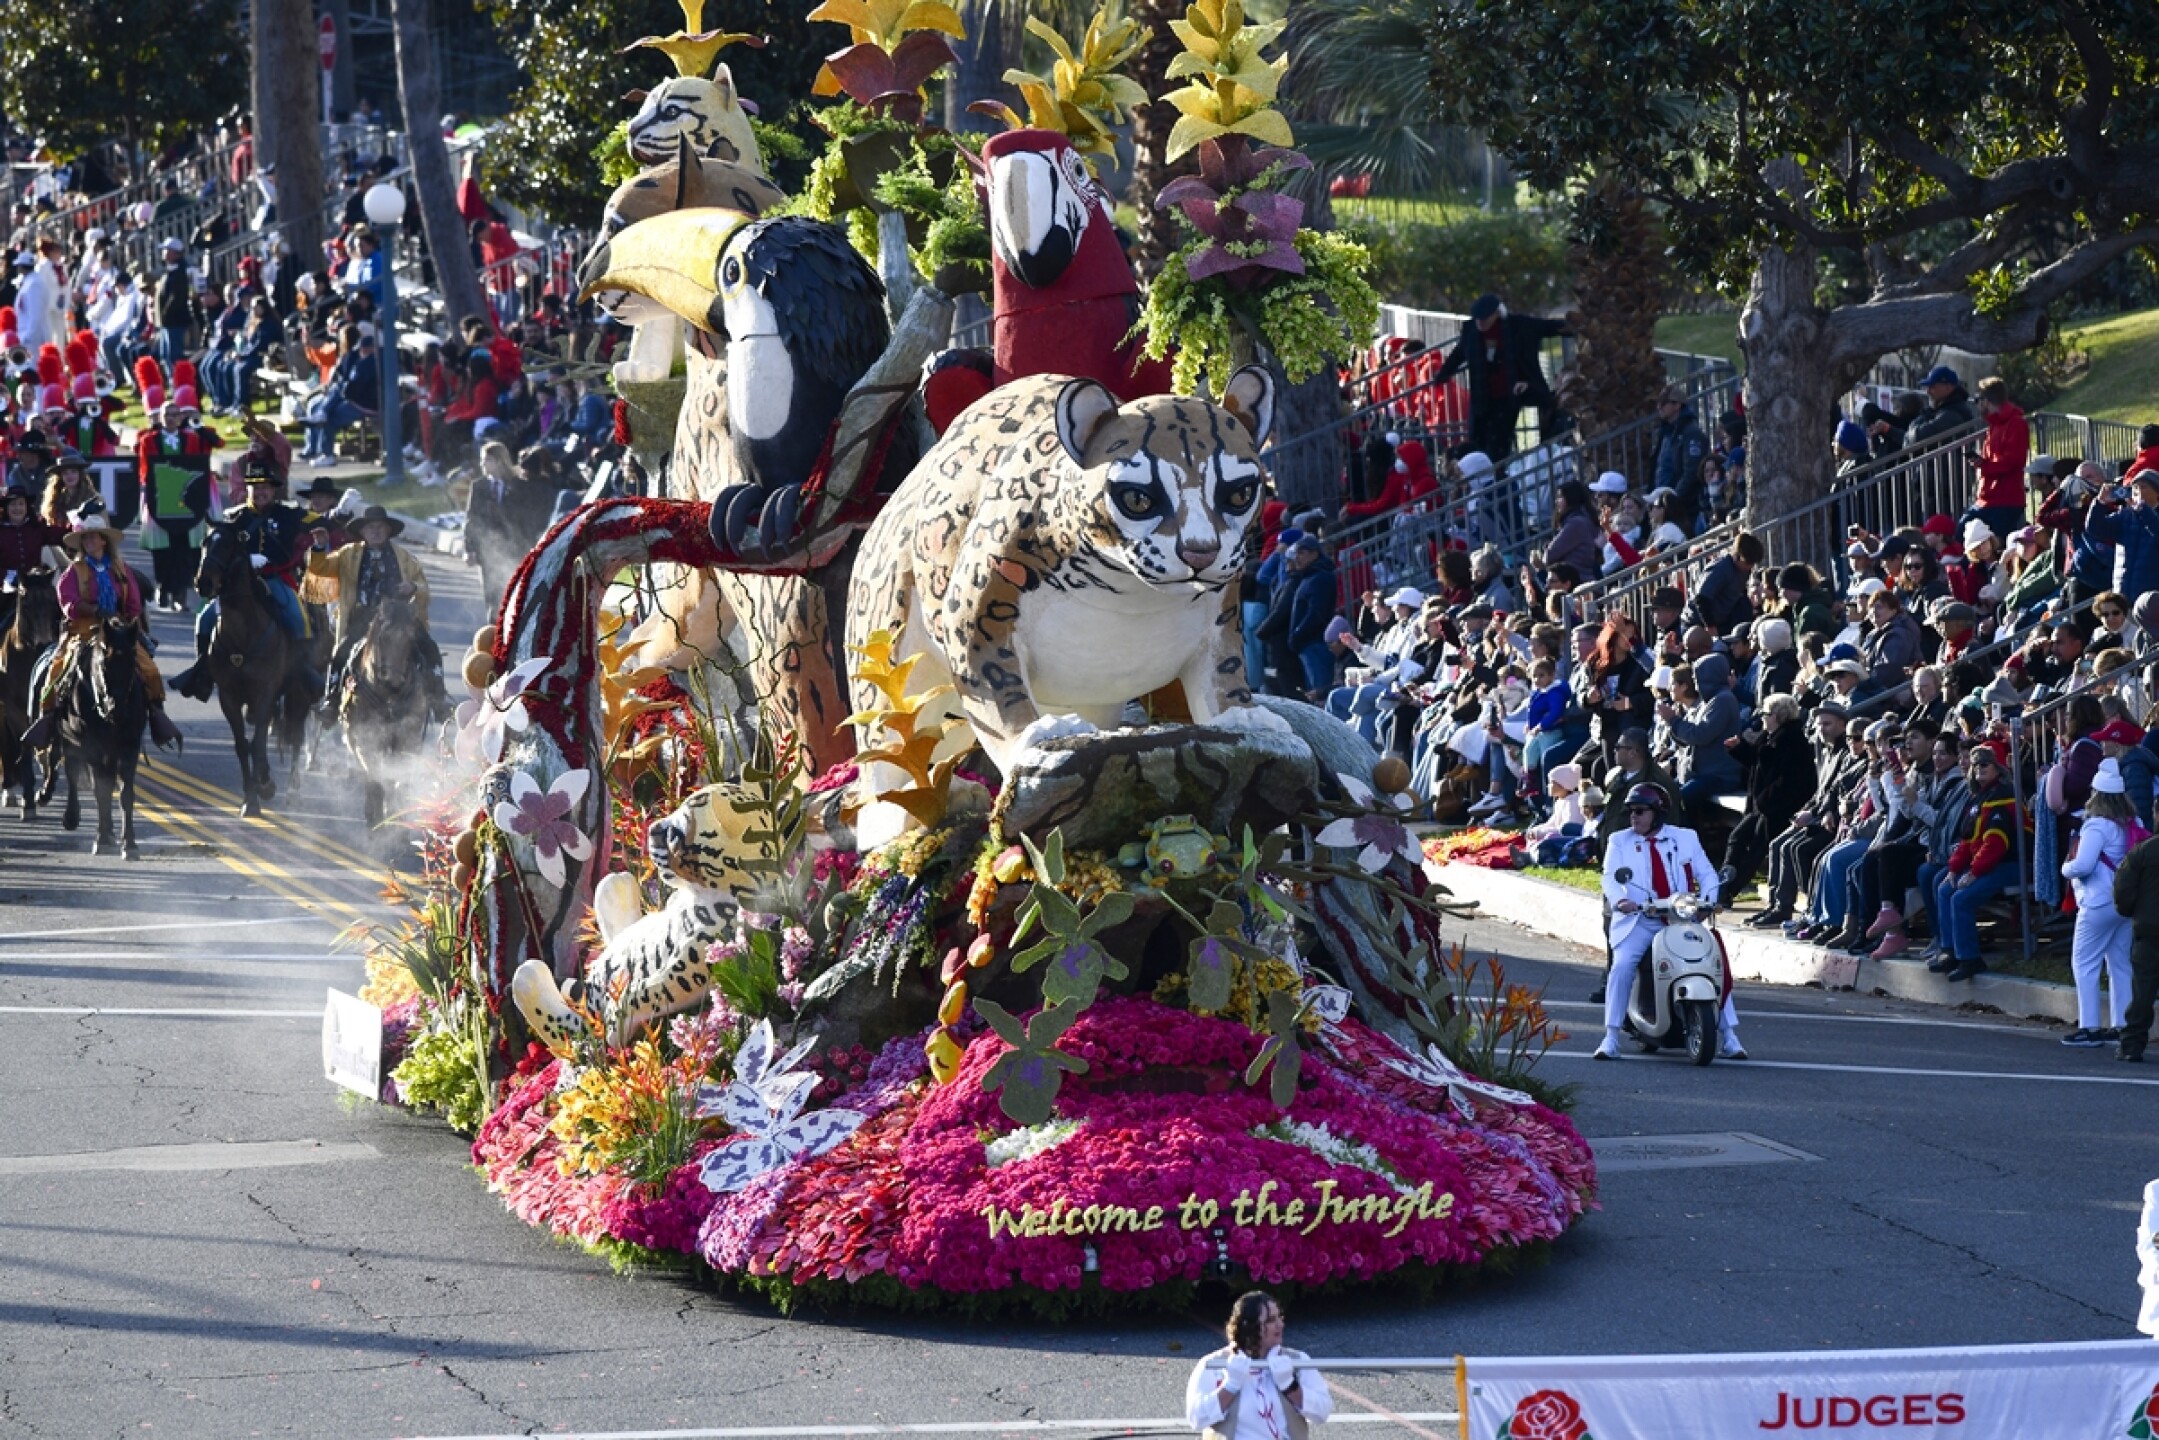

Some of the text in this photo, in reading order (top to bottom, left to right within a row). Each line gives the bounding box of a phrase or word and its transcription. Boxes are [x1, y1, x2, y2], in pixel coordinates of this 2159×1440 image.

[980, 1179, 1455, 1239] Welcome to the Jungle
[1759, 1392, 1966, 1430] JUDGES
